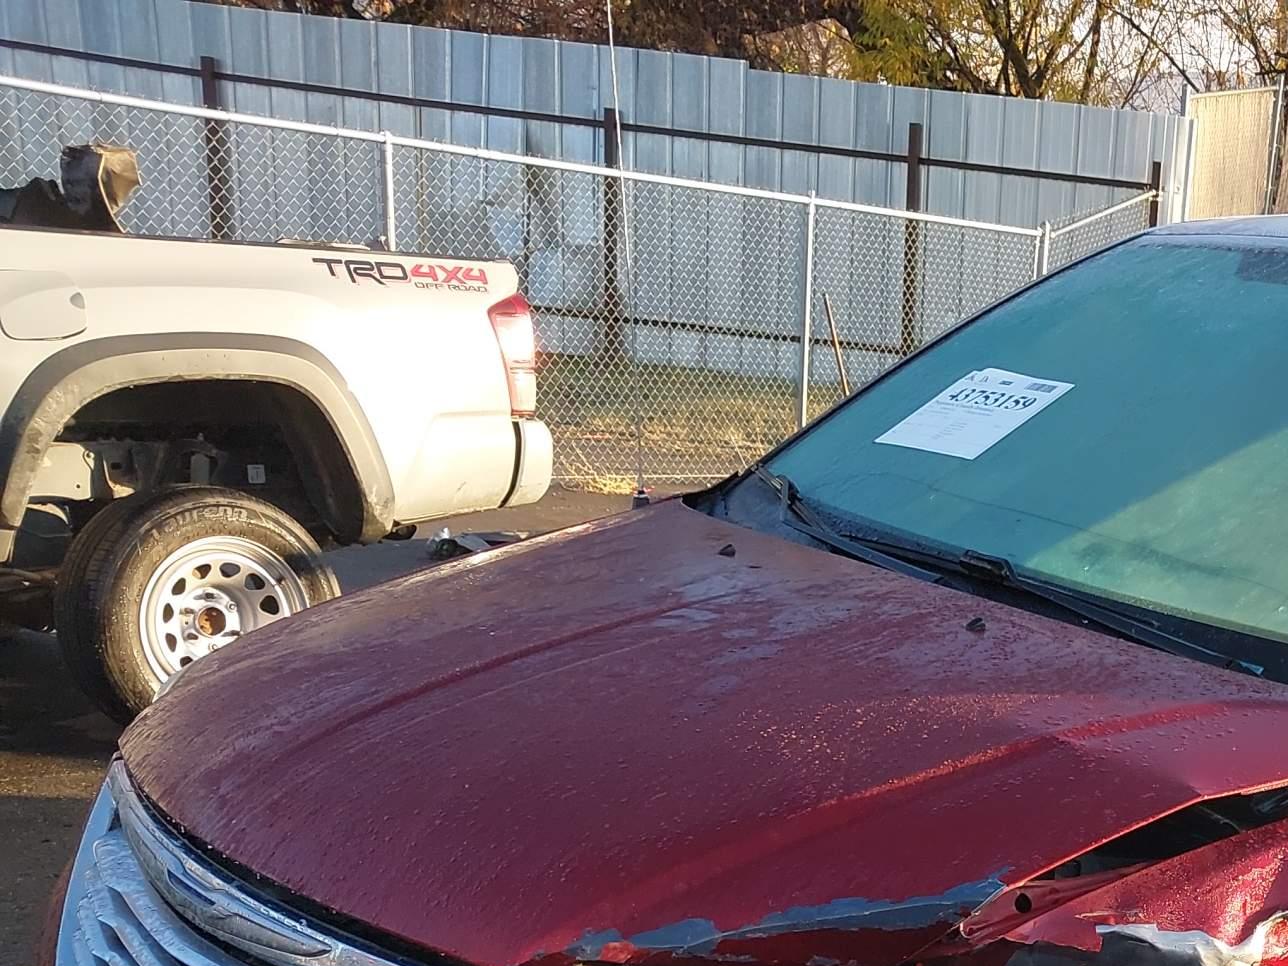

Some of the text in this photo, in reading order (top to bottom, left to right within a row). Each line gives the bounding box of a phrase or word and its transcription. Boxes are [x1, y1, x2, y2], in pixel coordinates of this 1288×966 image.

[312, 257, 410, 286] TRD
[414, 281, 489, 293] OFF ROAD
[948, 387, 1038, 411] 43753159
